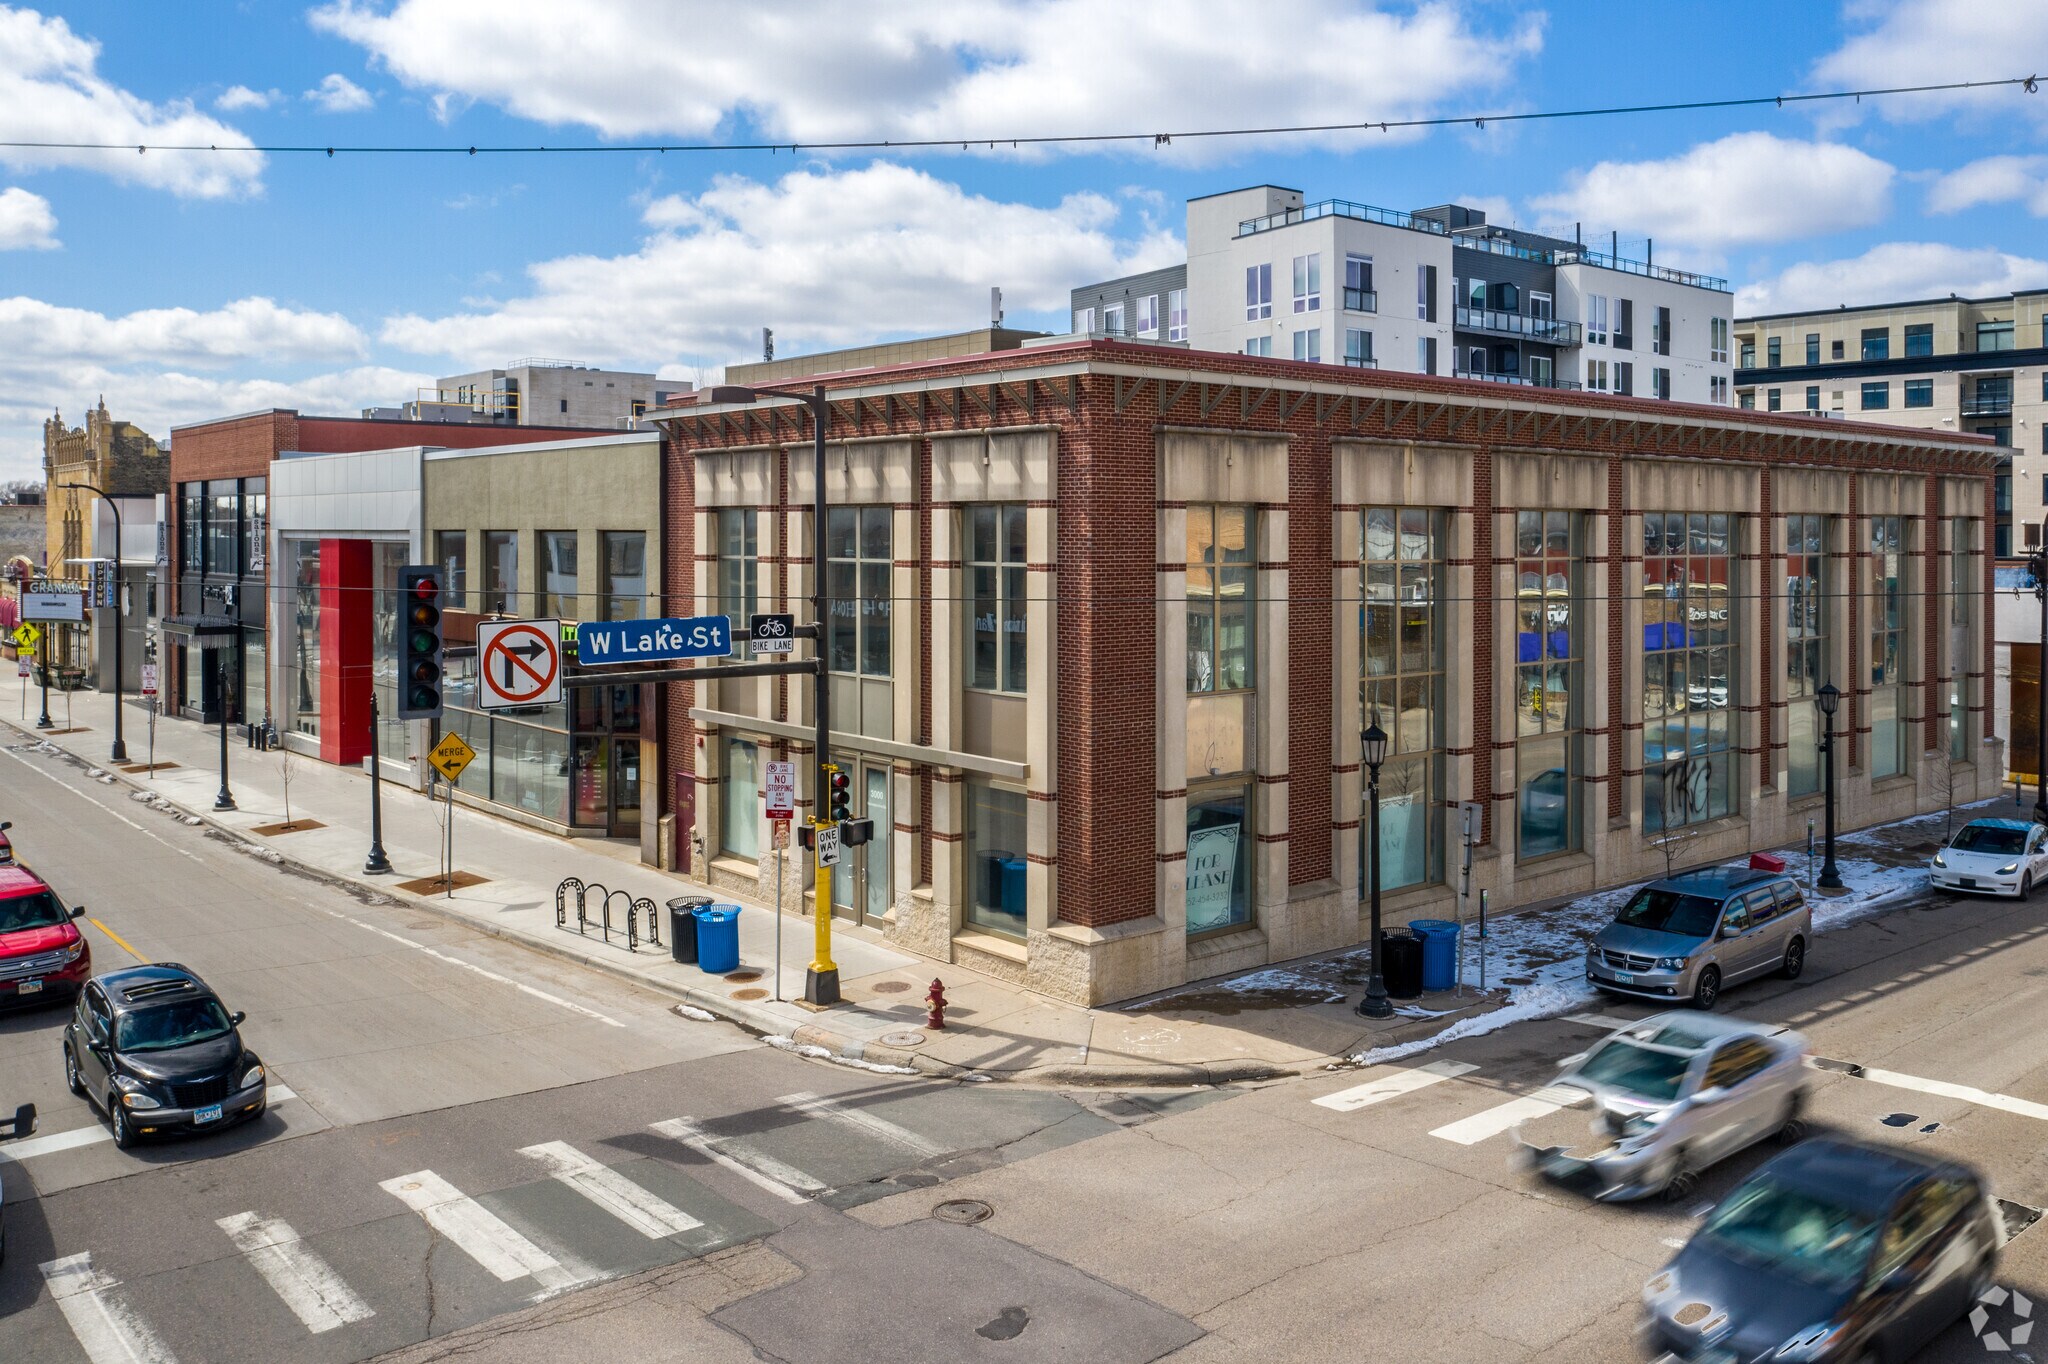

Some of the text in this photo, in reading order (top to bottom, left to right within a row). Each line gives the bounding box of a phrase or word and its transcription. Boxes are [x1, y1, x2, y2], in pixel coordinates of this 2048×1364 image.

[29, 582, 80, 594] GRANADA
[96, 562, 104, 606] UPTOWN
[589, 626, 722, 655] W Lake St
[752, 640, 792, 651] BIKE LANE
[438, 746, 465, 757] MERGE
[774, 775, 787, 784] NO
[767, 784, 793, 792] STOPPING
[870, 789, 884, 800] 3000
[819, 830, 837, 842] ONE
[820, 840, 838, 853] WAY
[1194, 853, 1221, 871] FOR
[1186, 870, 1230, 891] LEASE
[1186, 890, 1228, 906] 52-454-3232
